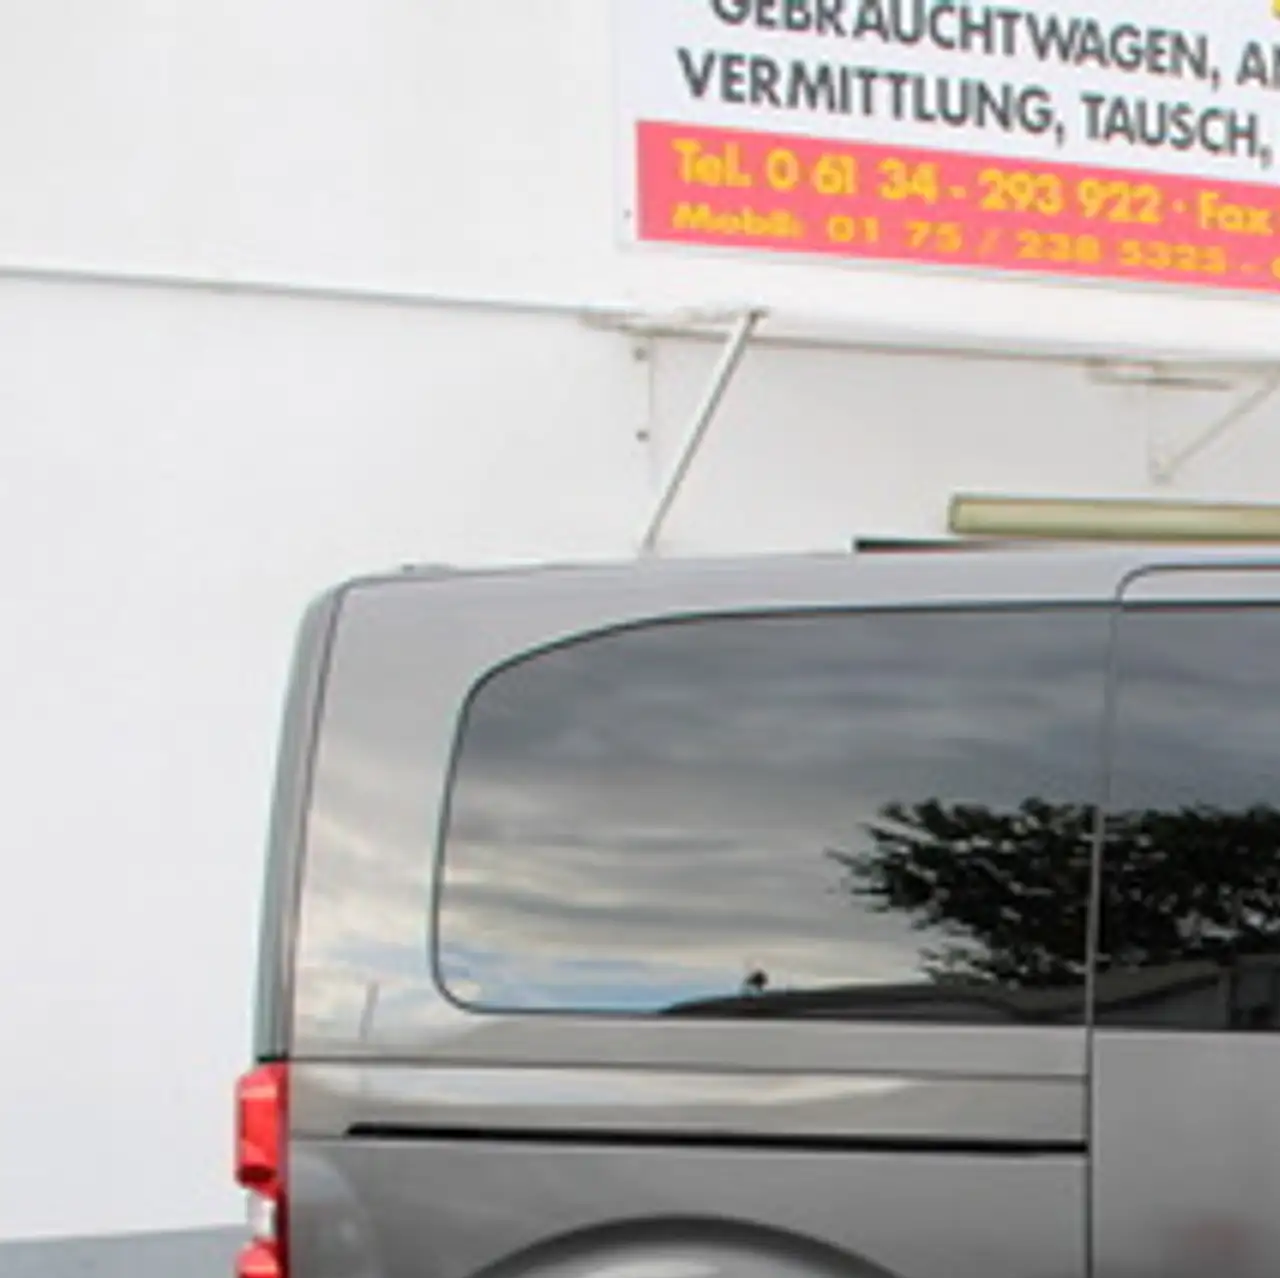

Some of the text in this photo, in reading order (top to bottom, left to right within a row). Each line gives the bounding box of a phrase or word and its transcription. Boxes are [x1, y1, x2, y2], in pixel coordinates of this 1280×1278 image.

[677, 46, 1063, 146] VERMITTLUNG,
[1081, 90, 1272, 167] TAUSCH,
[671, 138, 751, 187] Tel.
[811, 153, 855, 194] 61
[876, 157, 938, 204] 34
[977, 168, 1064, 215] 293
[1076, 177, 1162, 222] 922
[1199, 190, 1273, 236] Fax
